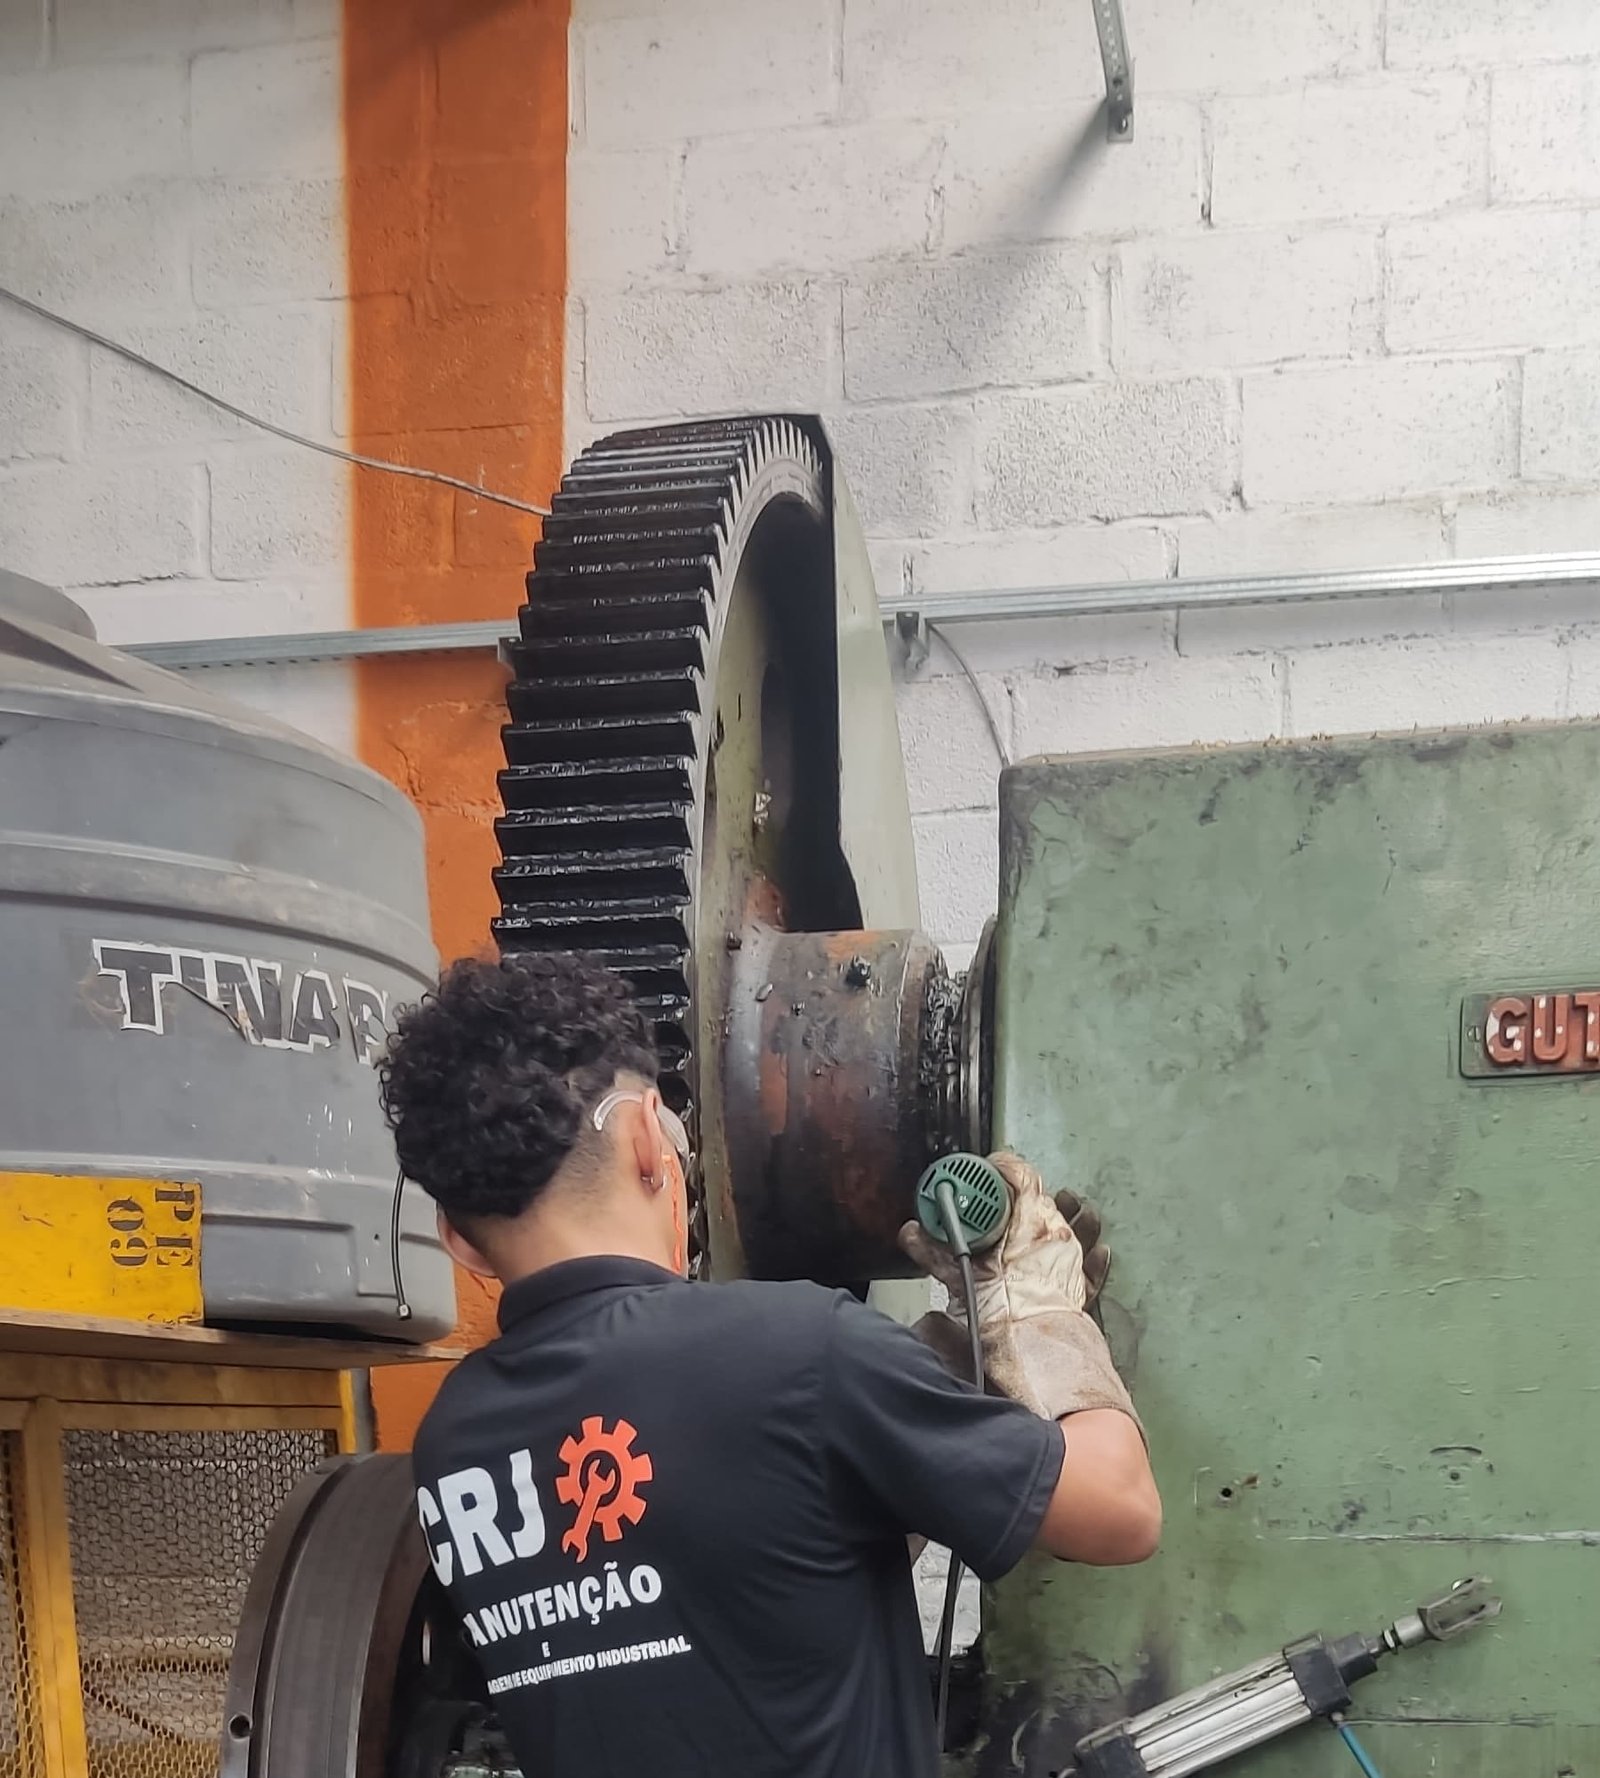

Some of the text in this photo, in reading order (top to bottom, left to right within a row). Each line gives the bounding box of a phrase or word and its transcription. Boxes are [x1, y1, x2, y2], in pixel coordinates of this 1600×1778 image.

[107, 1198, 149, 1267] 09
[155, 1188, 195, 1266] PE
[416, 1448, 546, 1587] CRJ
[462, 1561, 663, 1648] ANUTENÇÃO
[541, 1641, 551, 1658] E
[596, 1635, 691, 1668] INDUSTRIAL
